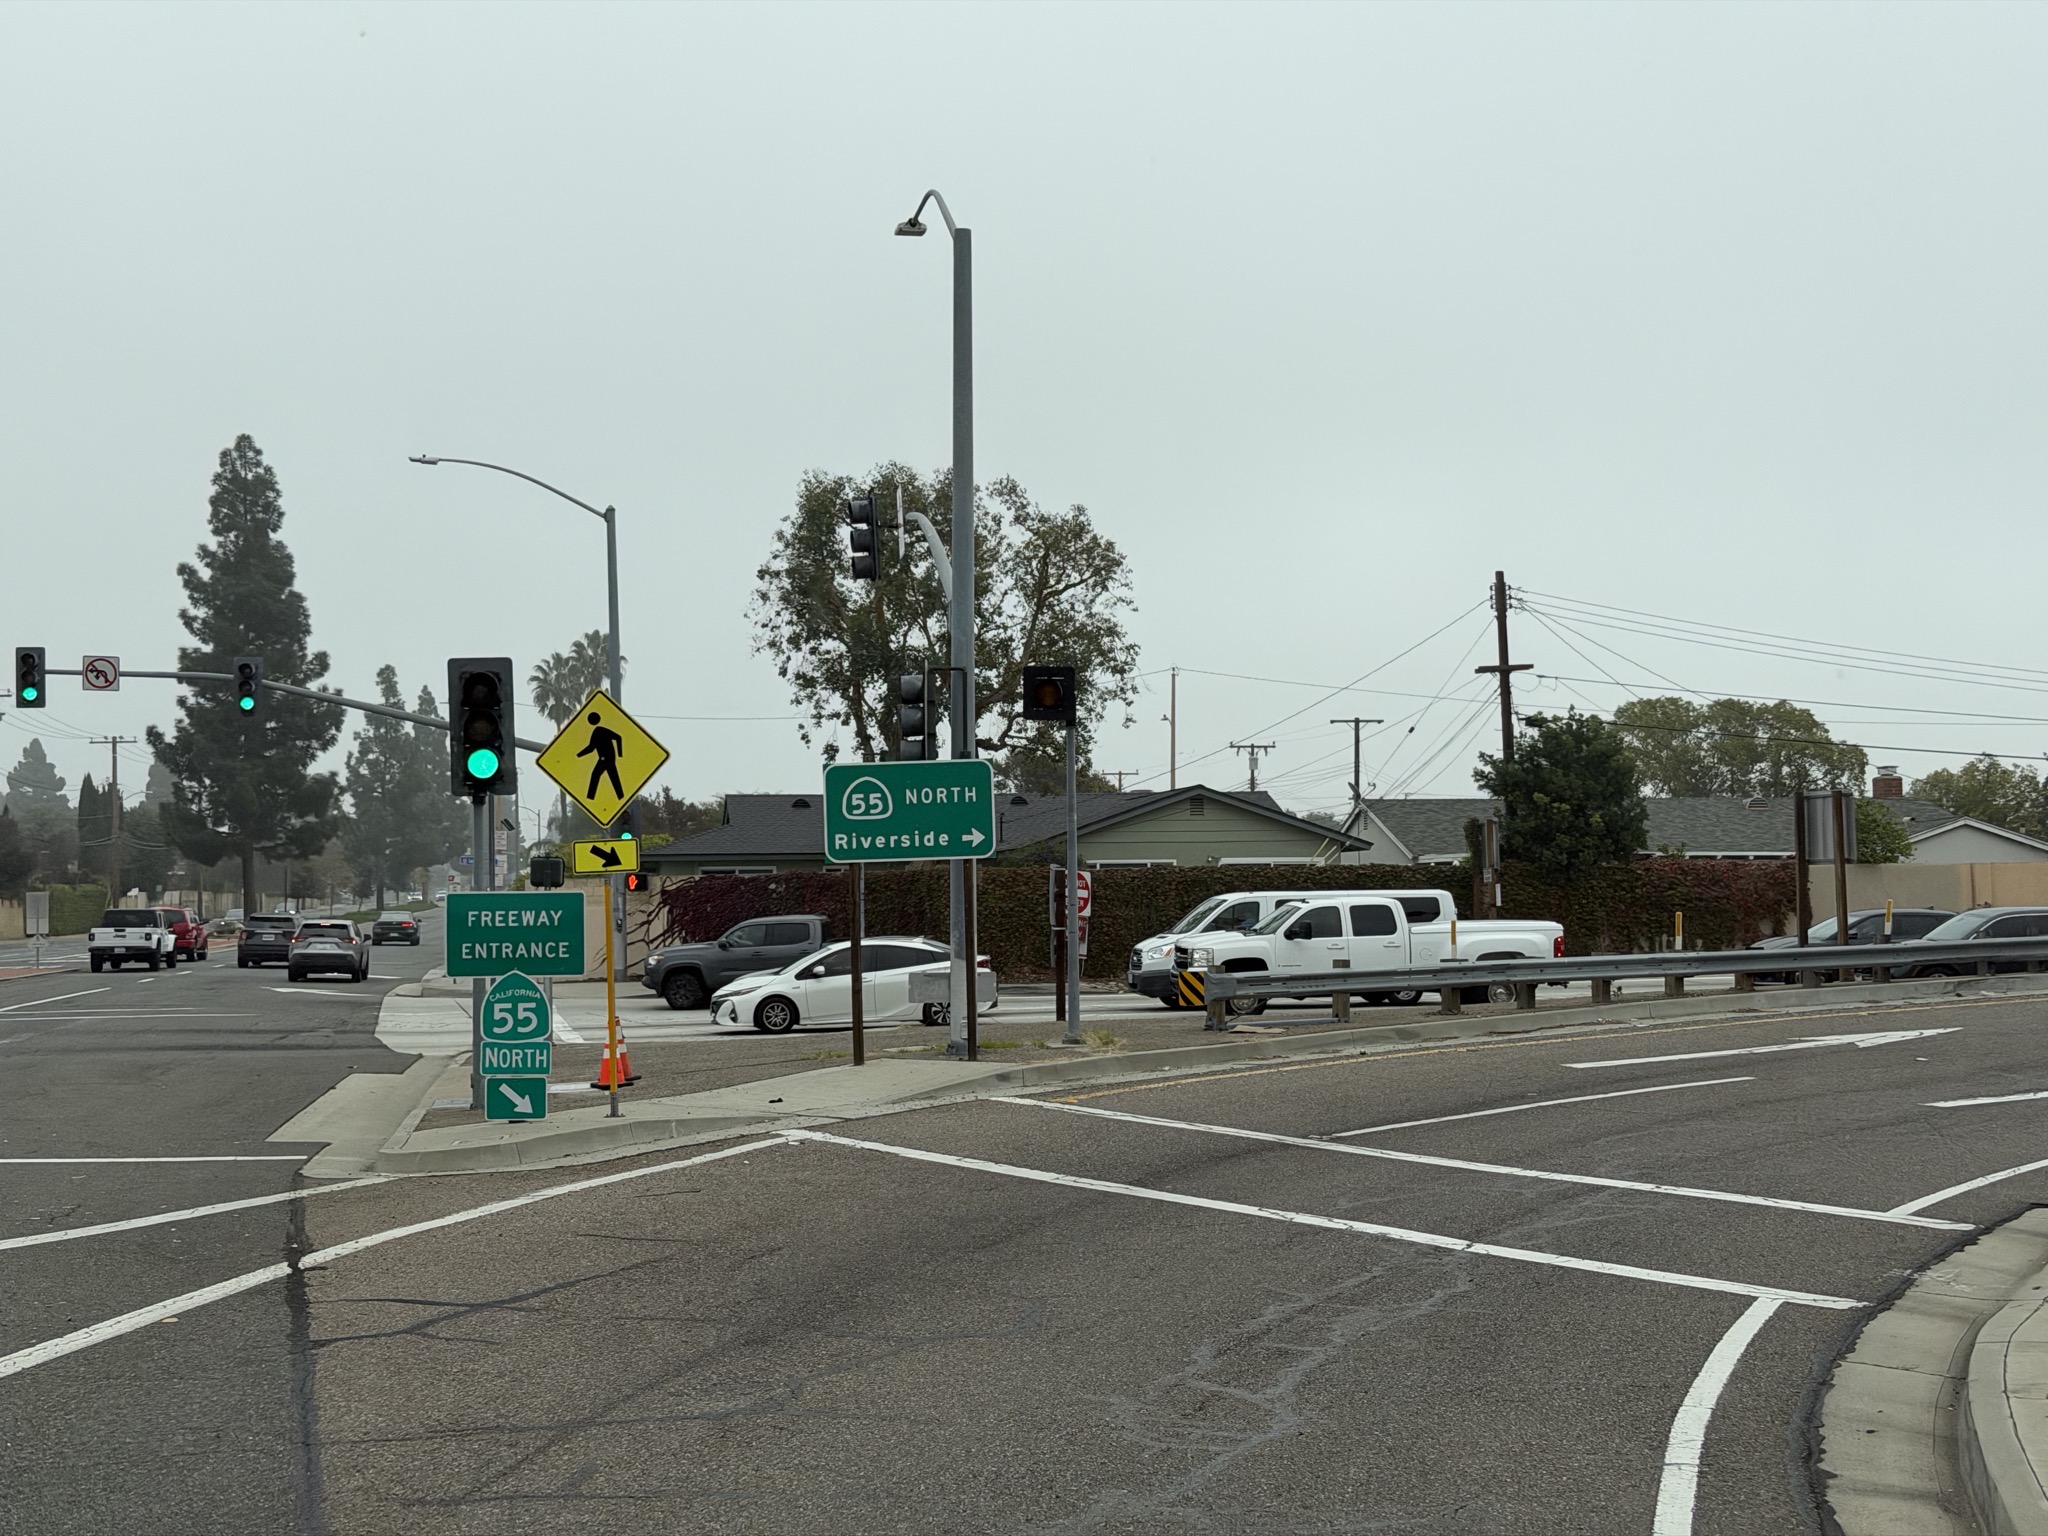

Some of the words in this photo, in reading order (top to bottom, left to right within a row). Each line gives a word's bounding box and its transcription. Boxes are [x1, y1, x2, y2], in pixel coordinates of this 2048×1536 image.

[851, 792, 884, 815] 55
[905, 786, 977, 805] NORTH
[834, 830, 949, 850] Riverside
[467, 910, 563, 927] FREEWAY
[461, 941, 570, 959] ENTRANCE
[489, 989, 541, 1002] CALIFORNIA
[492, 1002, 538, 1034] 55
[485, 1047, 547, 1069] NORTH
